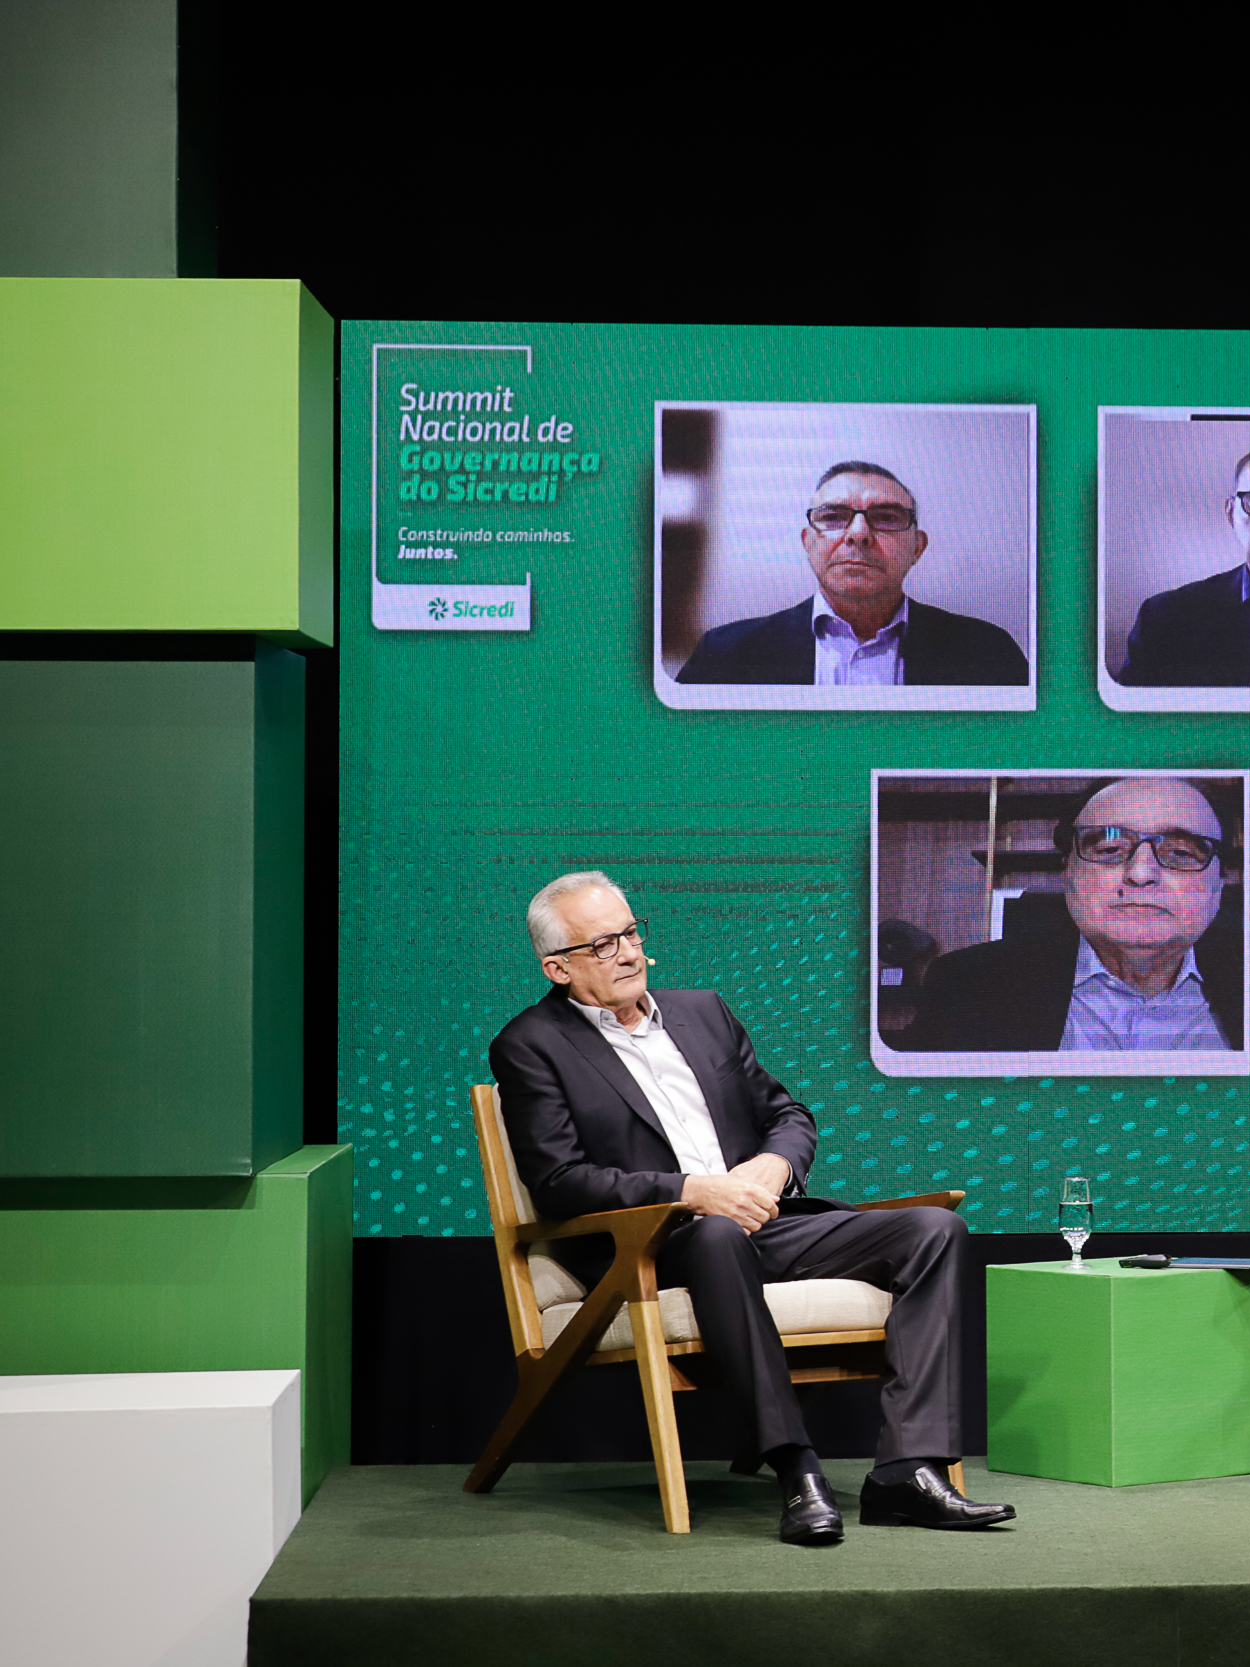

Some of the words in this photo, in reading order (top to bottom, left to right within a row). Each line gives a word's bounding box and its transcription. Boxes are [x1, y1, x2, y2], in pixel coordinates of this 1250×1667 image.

[399, 383, 514, 412] Summit
[399, 414, 530, 442] Nacional
[537, 414, 574, 443] de
[399, 445, 600, 480] Governança
[398, 474, 439, 501] do
[447, 473, 558, 502] Sicredi
[398, 527, 492, 542] Construindo
[496, 528, 575, 542] caminhos.
[398, 545, 458, 559] Juntos.
[453, 601, 515, 618] Sicredi
